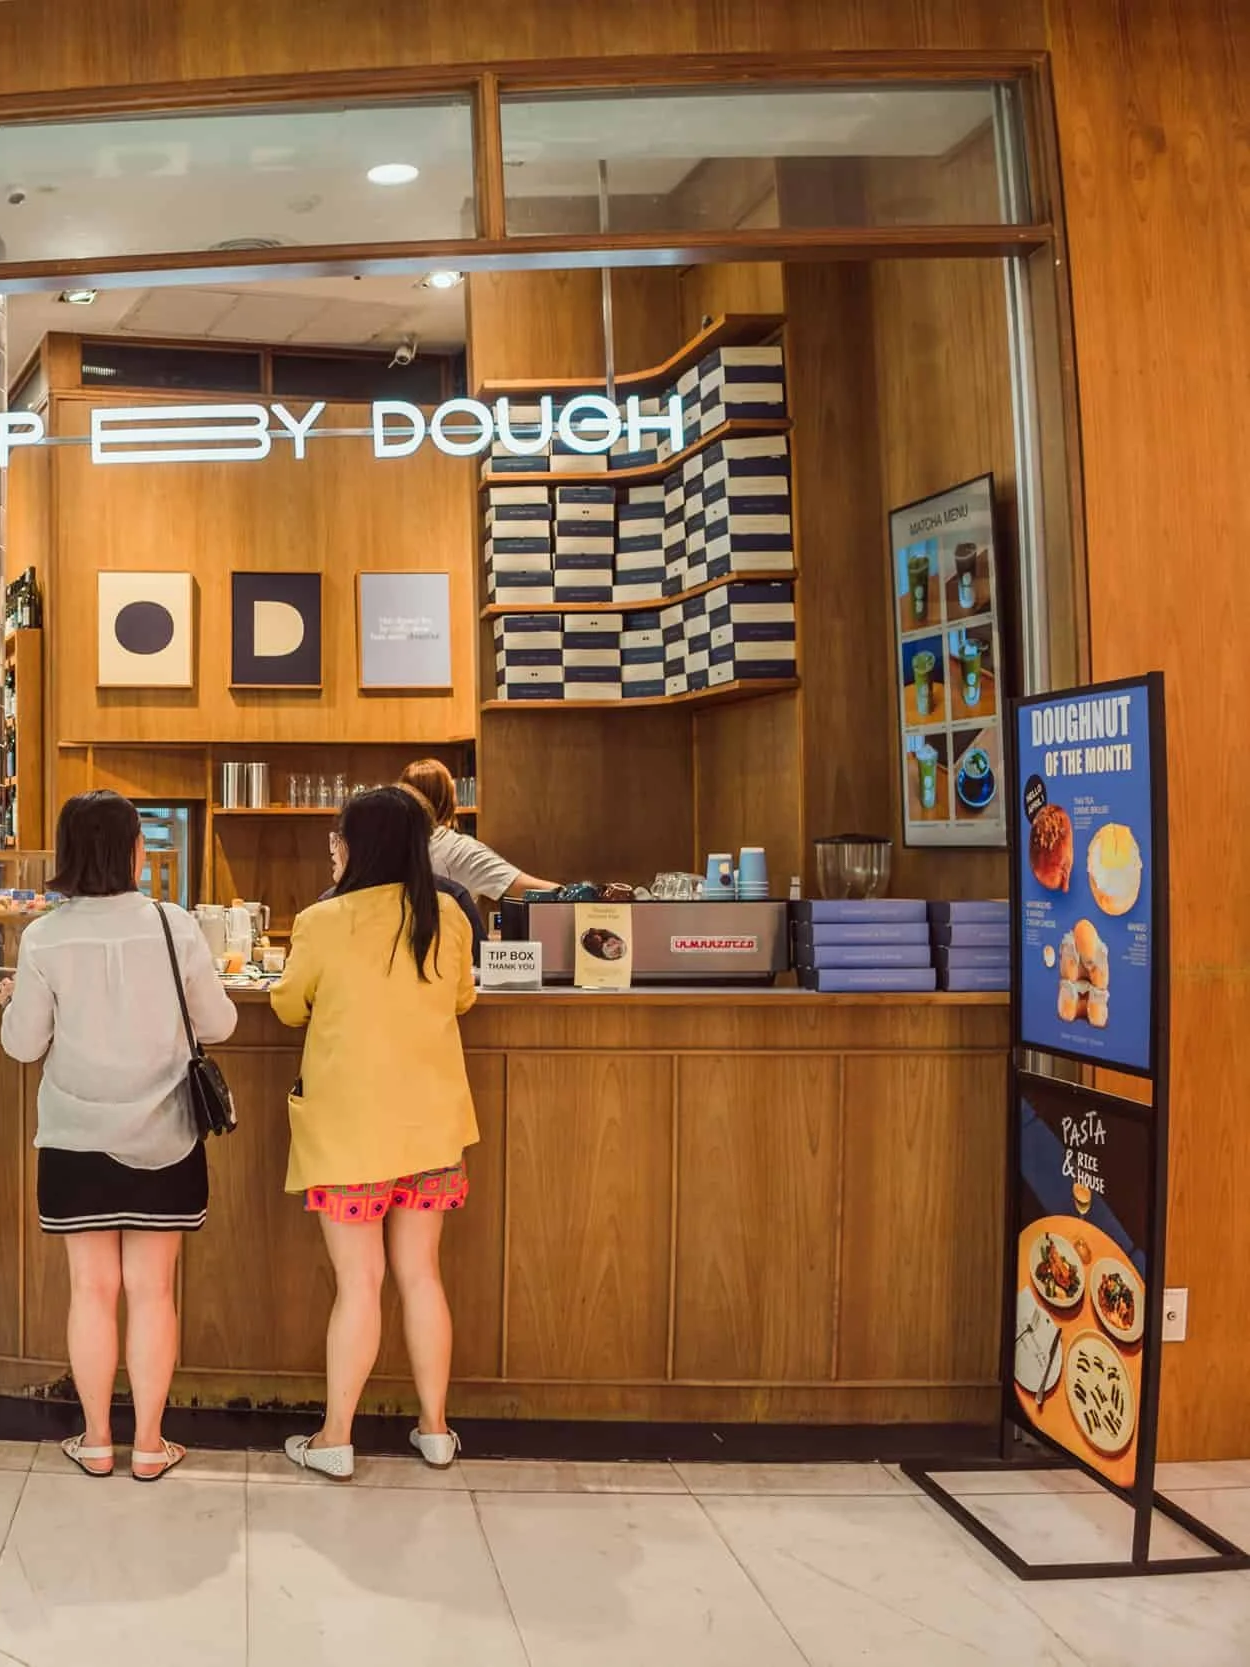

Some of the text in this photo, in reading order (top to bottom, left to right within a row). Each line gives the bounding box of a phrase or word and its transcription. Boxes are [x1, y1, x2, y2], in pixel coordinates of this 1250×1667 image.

[90, 400, 327, 465] BY
[372, 394, 684, 459] DOUGH
[943, 503, 969, 524] MENU
[1031, 695, 1131, 747] DOUGHNUT
[1045, 743, 1132, 777] OF THE MONTH
[488, 951, 534, 961] TIP BOX
[1061, 1110, 1107, 1147] PASTA
[1062, 1149, 1099, 1178] & RICE
[1077, 1169, 1105, 1195] HOUSE
